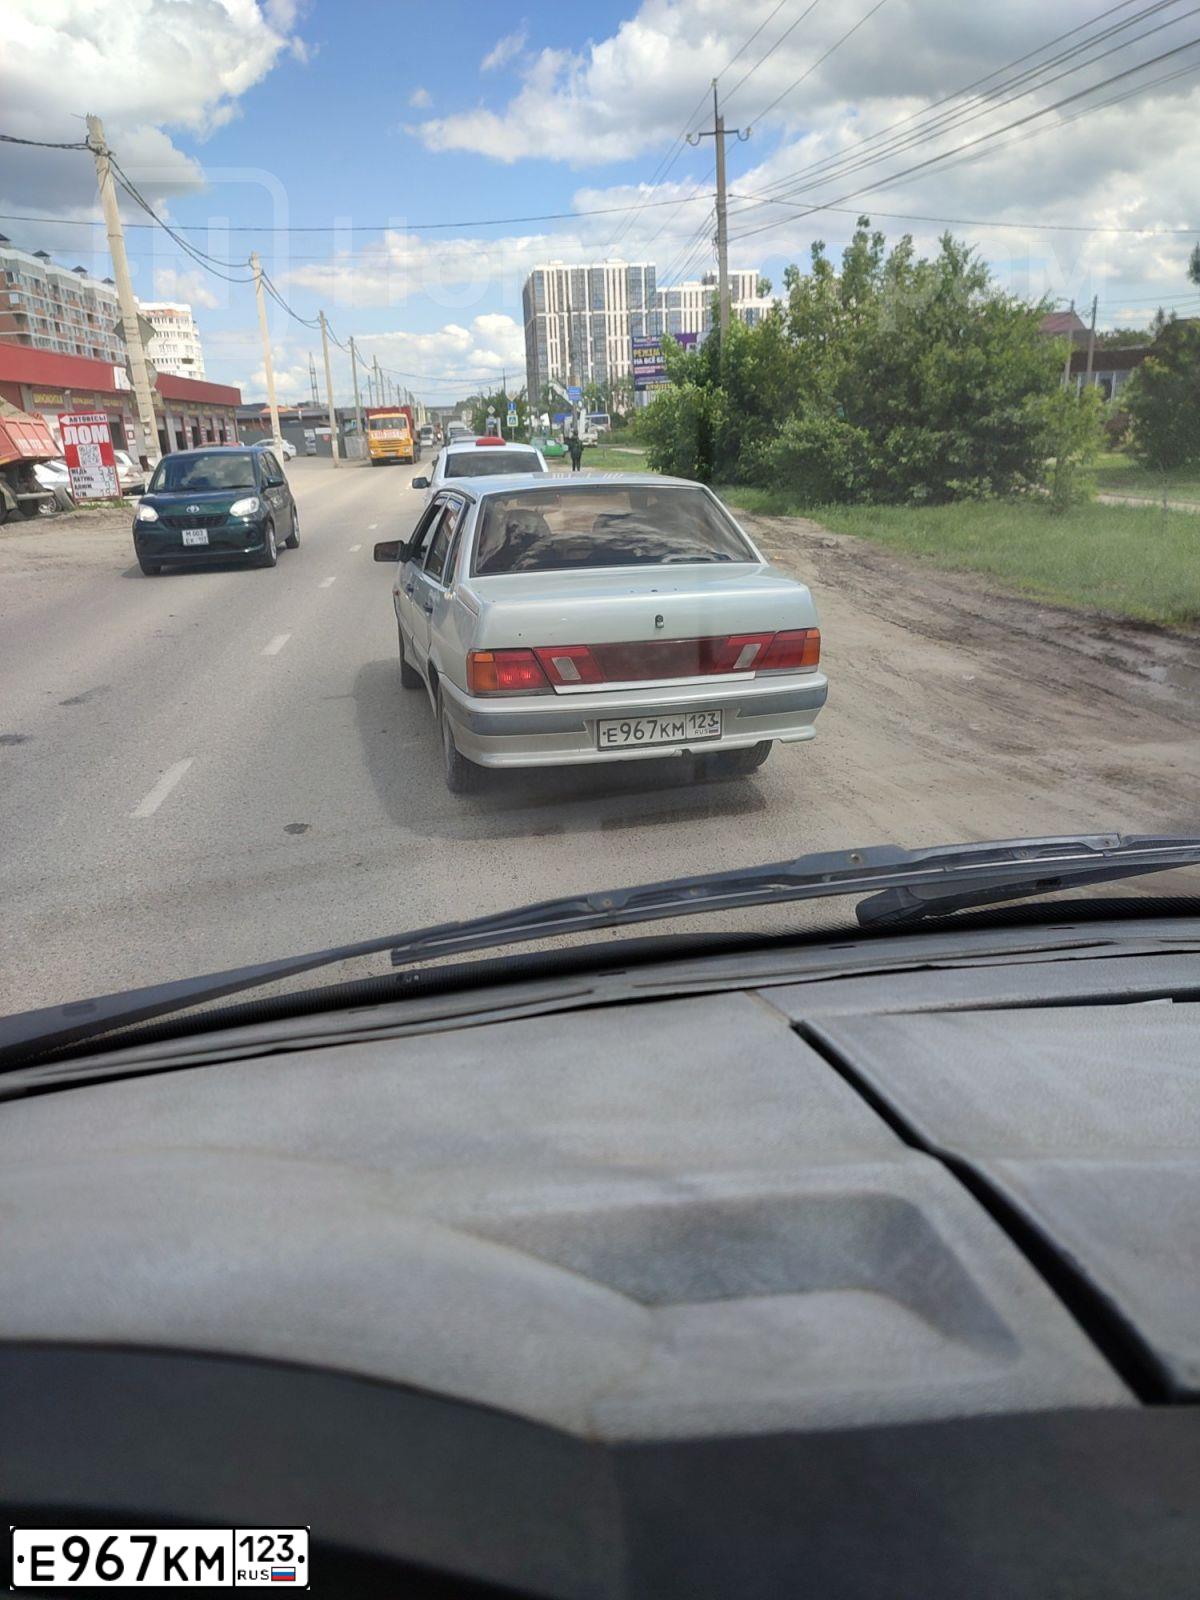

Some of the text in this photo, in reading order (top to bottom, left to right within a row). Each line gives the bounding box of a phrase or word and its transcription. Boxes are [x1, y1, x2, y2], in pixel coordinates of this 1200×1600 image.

[63, 424, 109, 445] ЛОМ
[606, 713, 716, 743] Е967КМ 123
